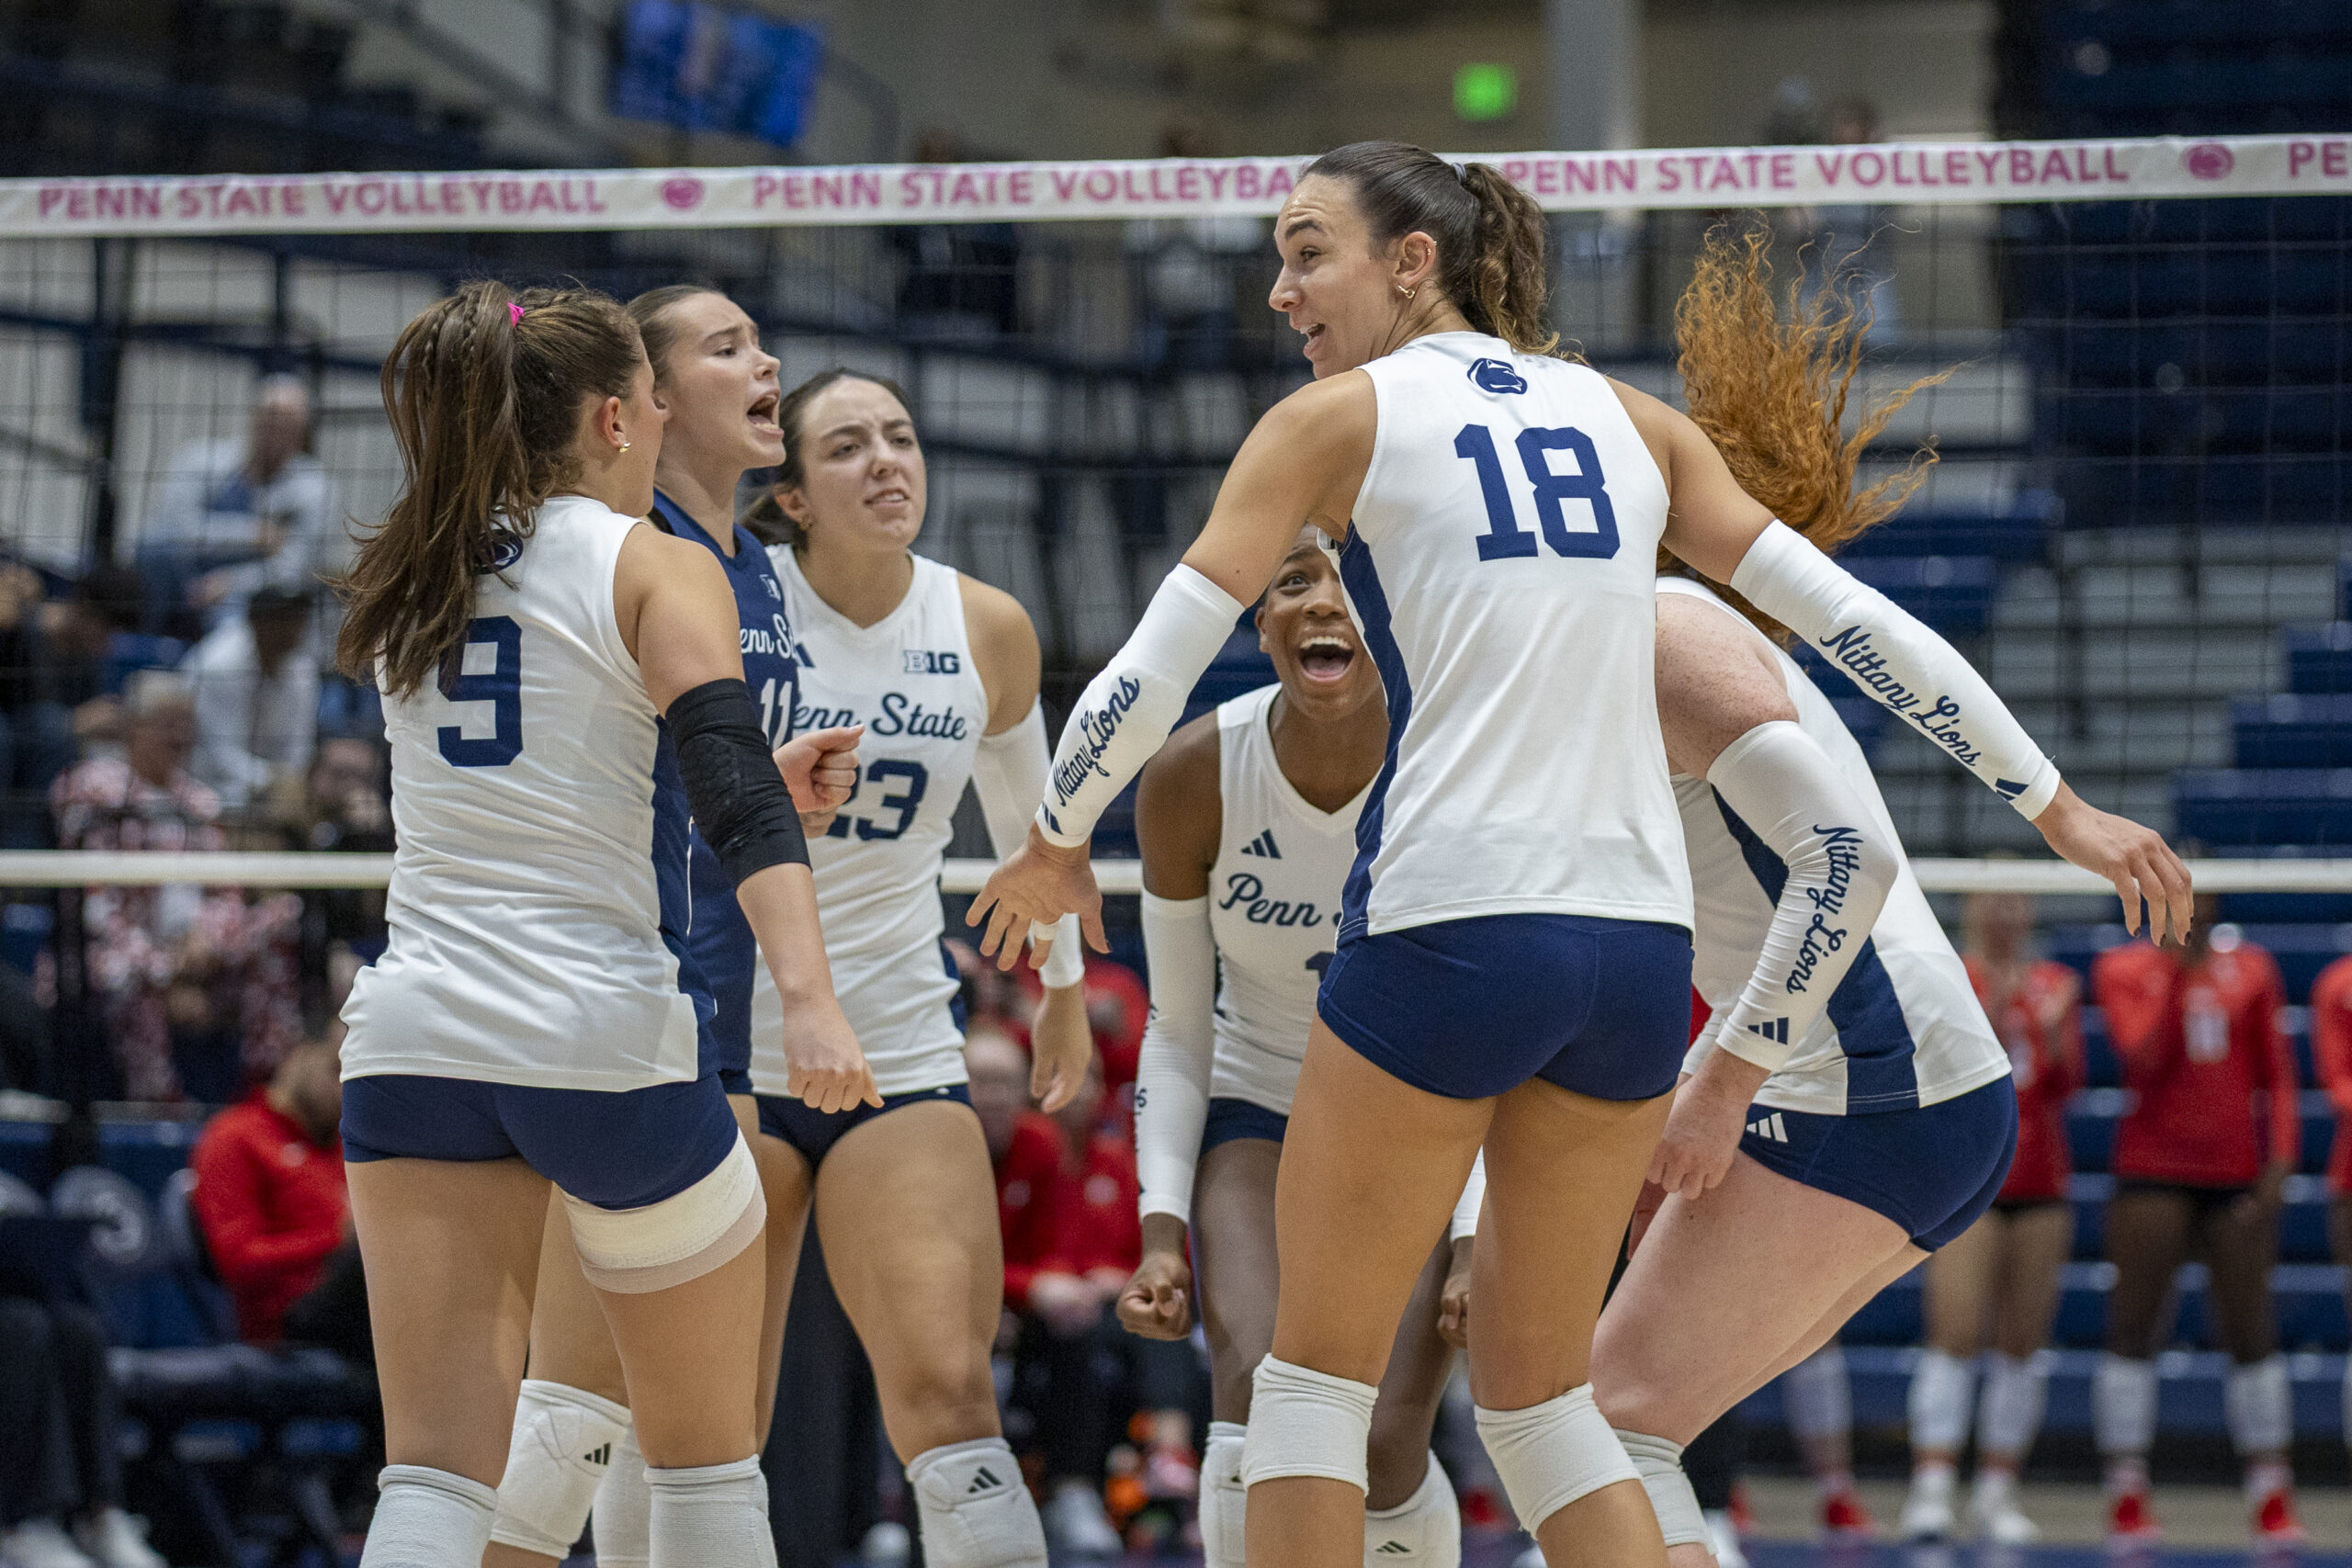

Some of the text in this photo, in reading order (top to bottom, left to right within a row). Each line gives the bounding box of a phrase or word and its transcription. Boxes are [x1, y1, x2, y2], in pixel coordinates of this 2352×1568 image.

[1504, 148, 2129, 195] PENN STATE VOLLEYBALL
[2288, 141, 2348, 177] PE
[38, 179, 608, 220] PENN STATE VOLLEYBALL
[754, 164, 1294, 209] PENN STATE VOLLEYBA
[1453, 423, 1621, 561] 18
[740, 628, 775, 654] enn
[437, 615, 523, 767] 9
[760, 678, 793, 753] 11
[793, 693, 967, 741] enn State
[1080, 676, 1139, 759] Lions
[1819, 626, 1981, 767] Nittany Lions
[1219, 873, 1323, 927] Penn
[1785, 823, 1864, 995] Nittany Lions
